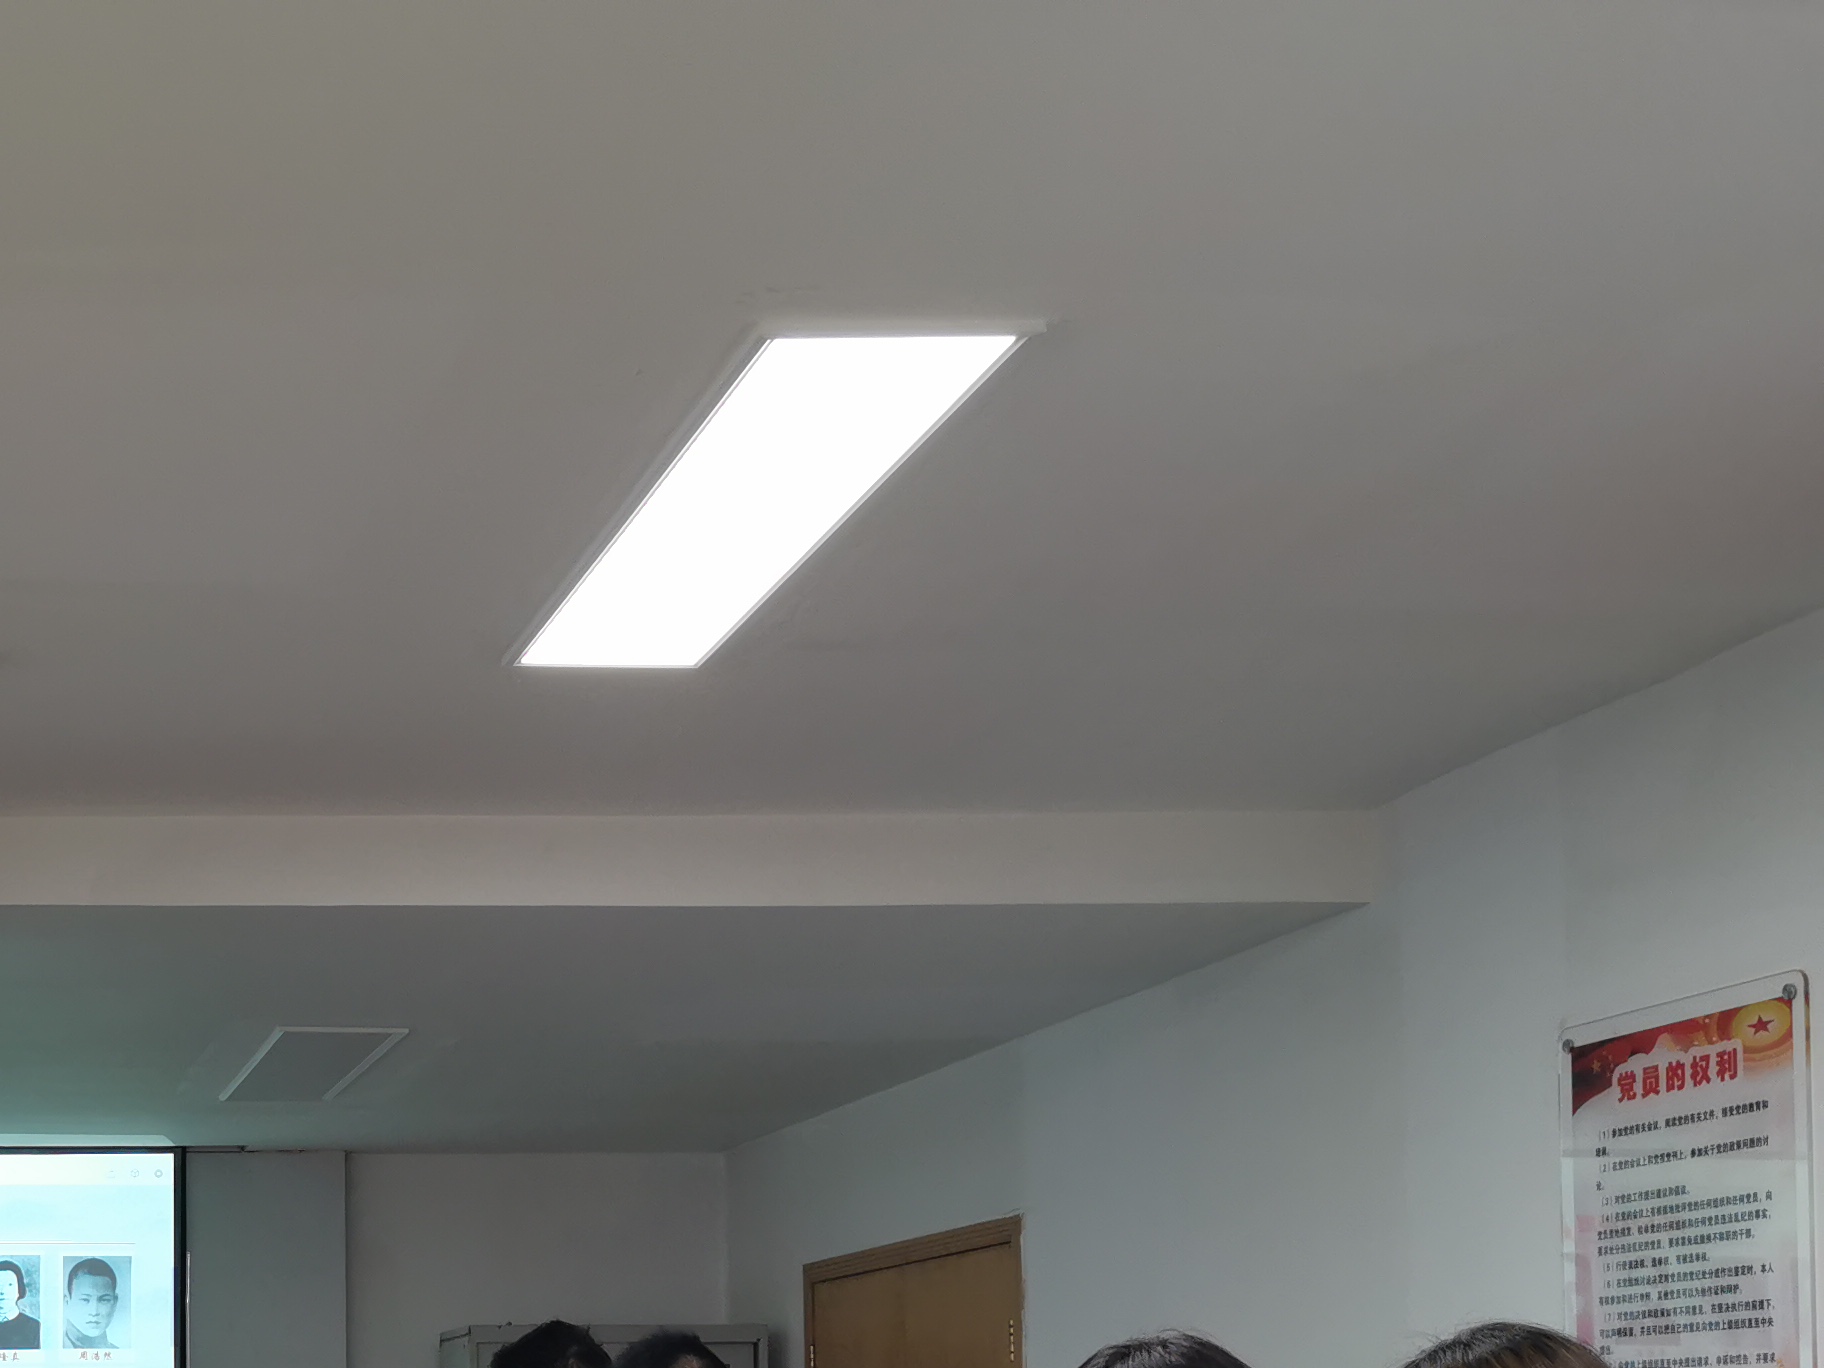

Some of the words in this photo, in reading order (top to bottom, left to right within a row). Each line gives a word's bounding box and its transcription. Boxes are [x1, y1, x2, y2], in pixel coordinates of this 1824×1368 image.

[1617, 1048, 1738, 1103] 党员的权利
